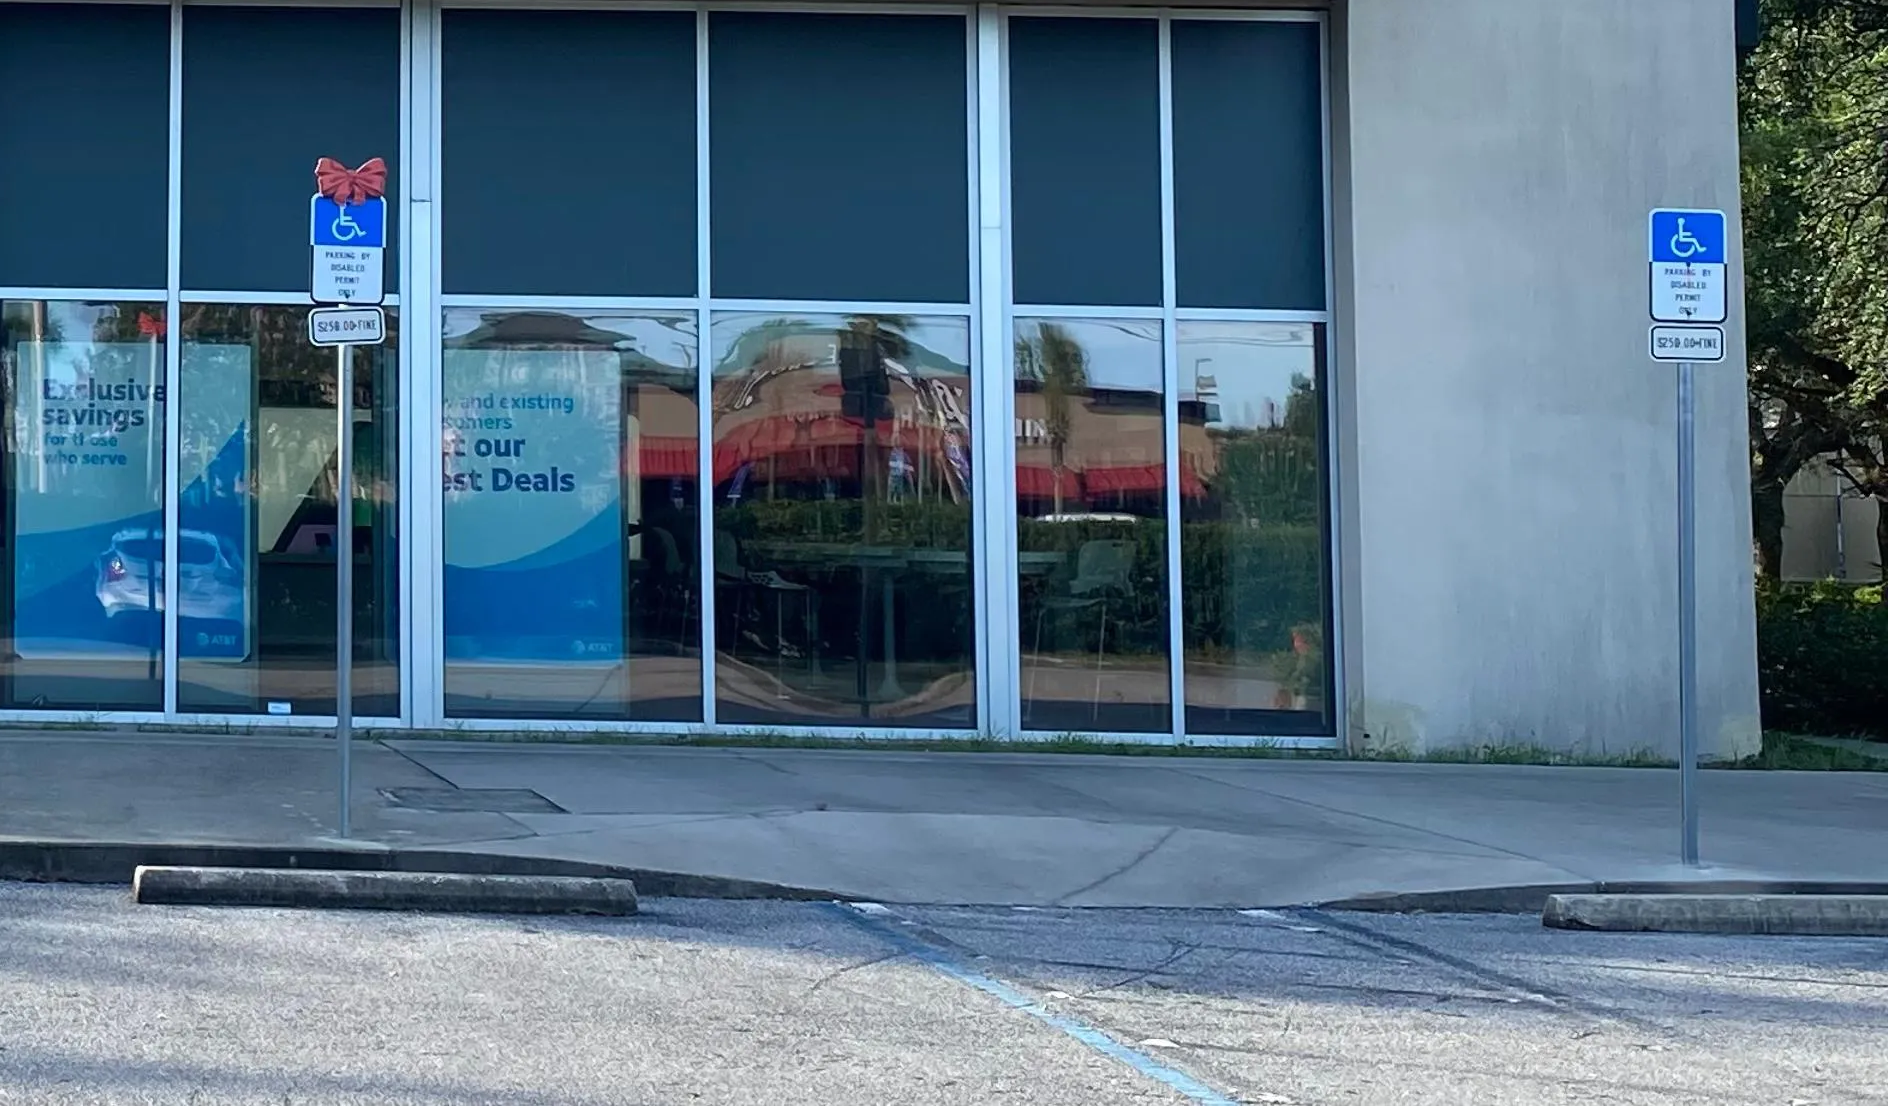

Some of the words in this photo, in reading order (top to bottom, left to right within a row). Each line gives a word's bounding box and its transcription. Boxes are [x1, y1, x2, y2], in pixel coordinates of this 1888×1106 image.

[325, 251, 355, 260] PARKING
[361, 252, 371, 261] BY
[331, 264, 364, 272] DISABLED
[1664, 268, 1696, 276] PARKING
[1702, 269, 1712, 278] BY
[335, 276, 359, 284] PERMIT
[1670, 280, 1707, 290] DISABLED
[1675, 293, 1702, 302] PERMIT
[358, 318, 377, 331] FINE
[1699, 337, 1718, 349] FINE
[43, 377, 166, 402] Exclusive
[499, 392, 575, 414] existing
[42, 402, 145, 433] savings
[45, 433, 68, 447] for
[474, 437, 526, 458] our
[45, 451, 78, 465] who
[81, 453, 127, 467] serve
[442, 469, 483, 493] est
[491, 466, 576, 493] Deals
